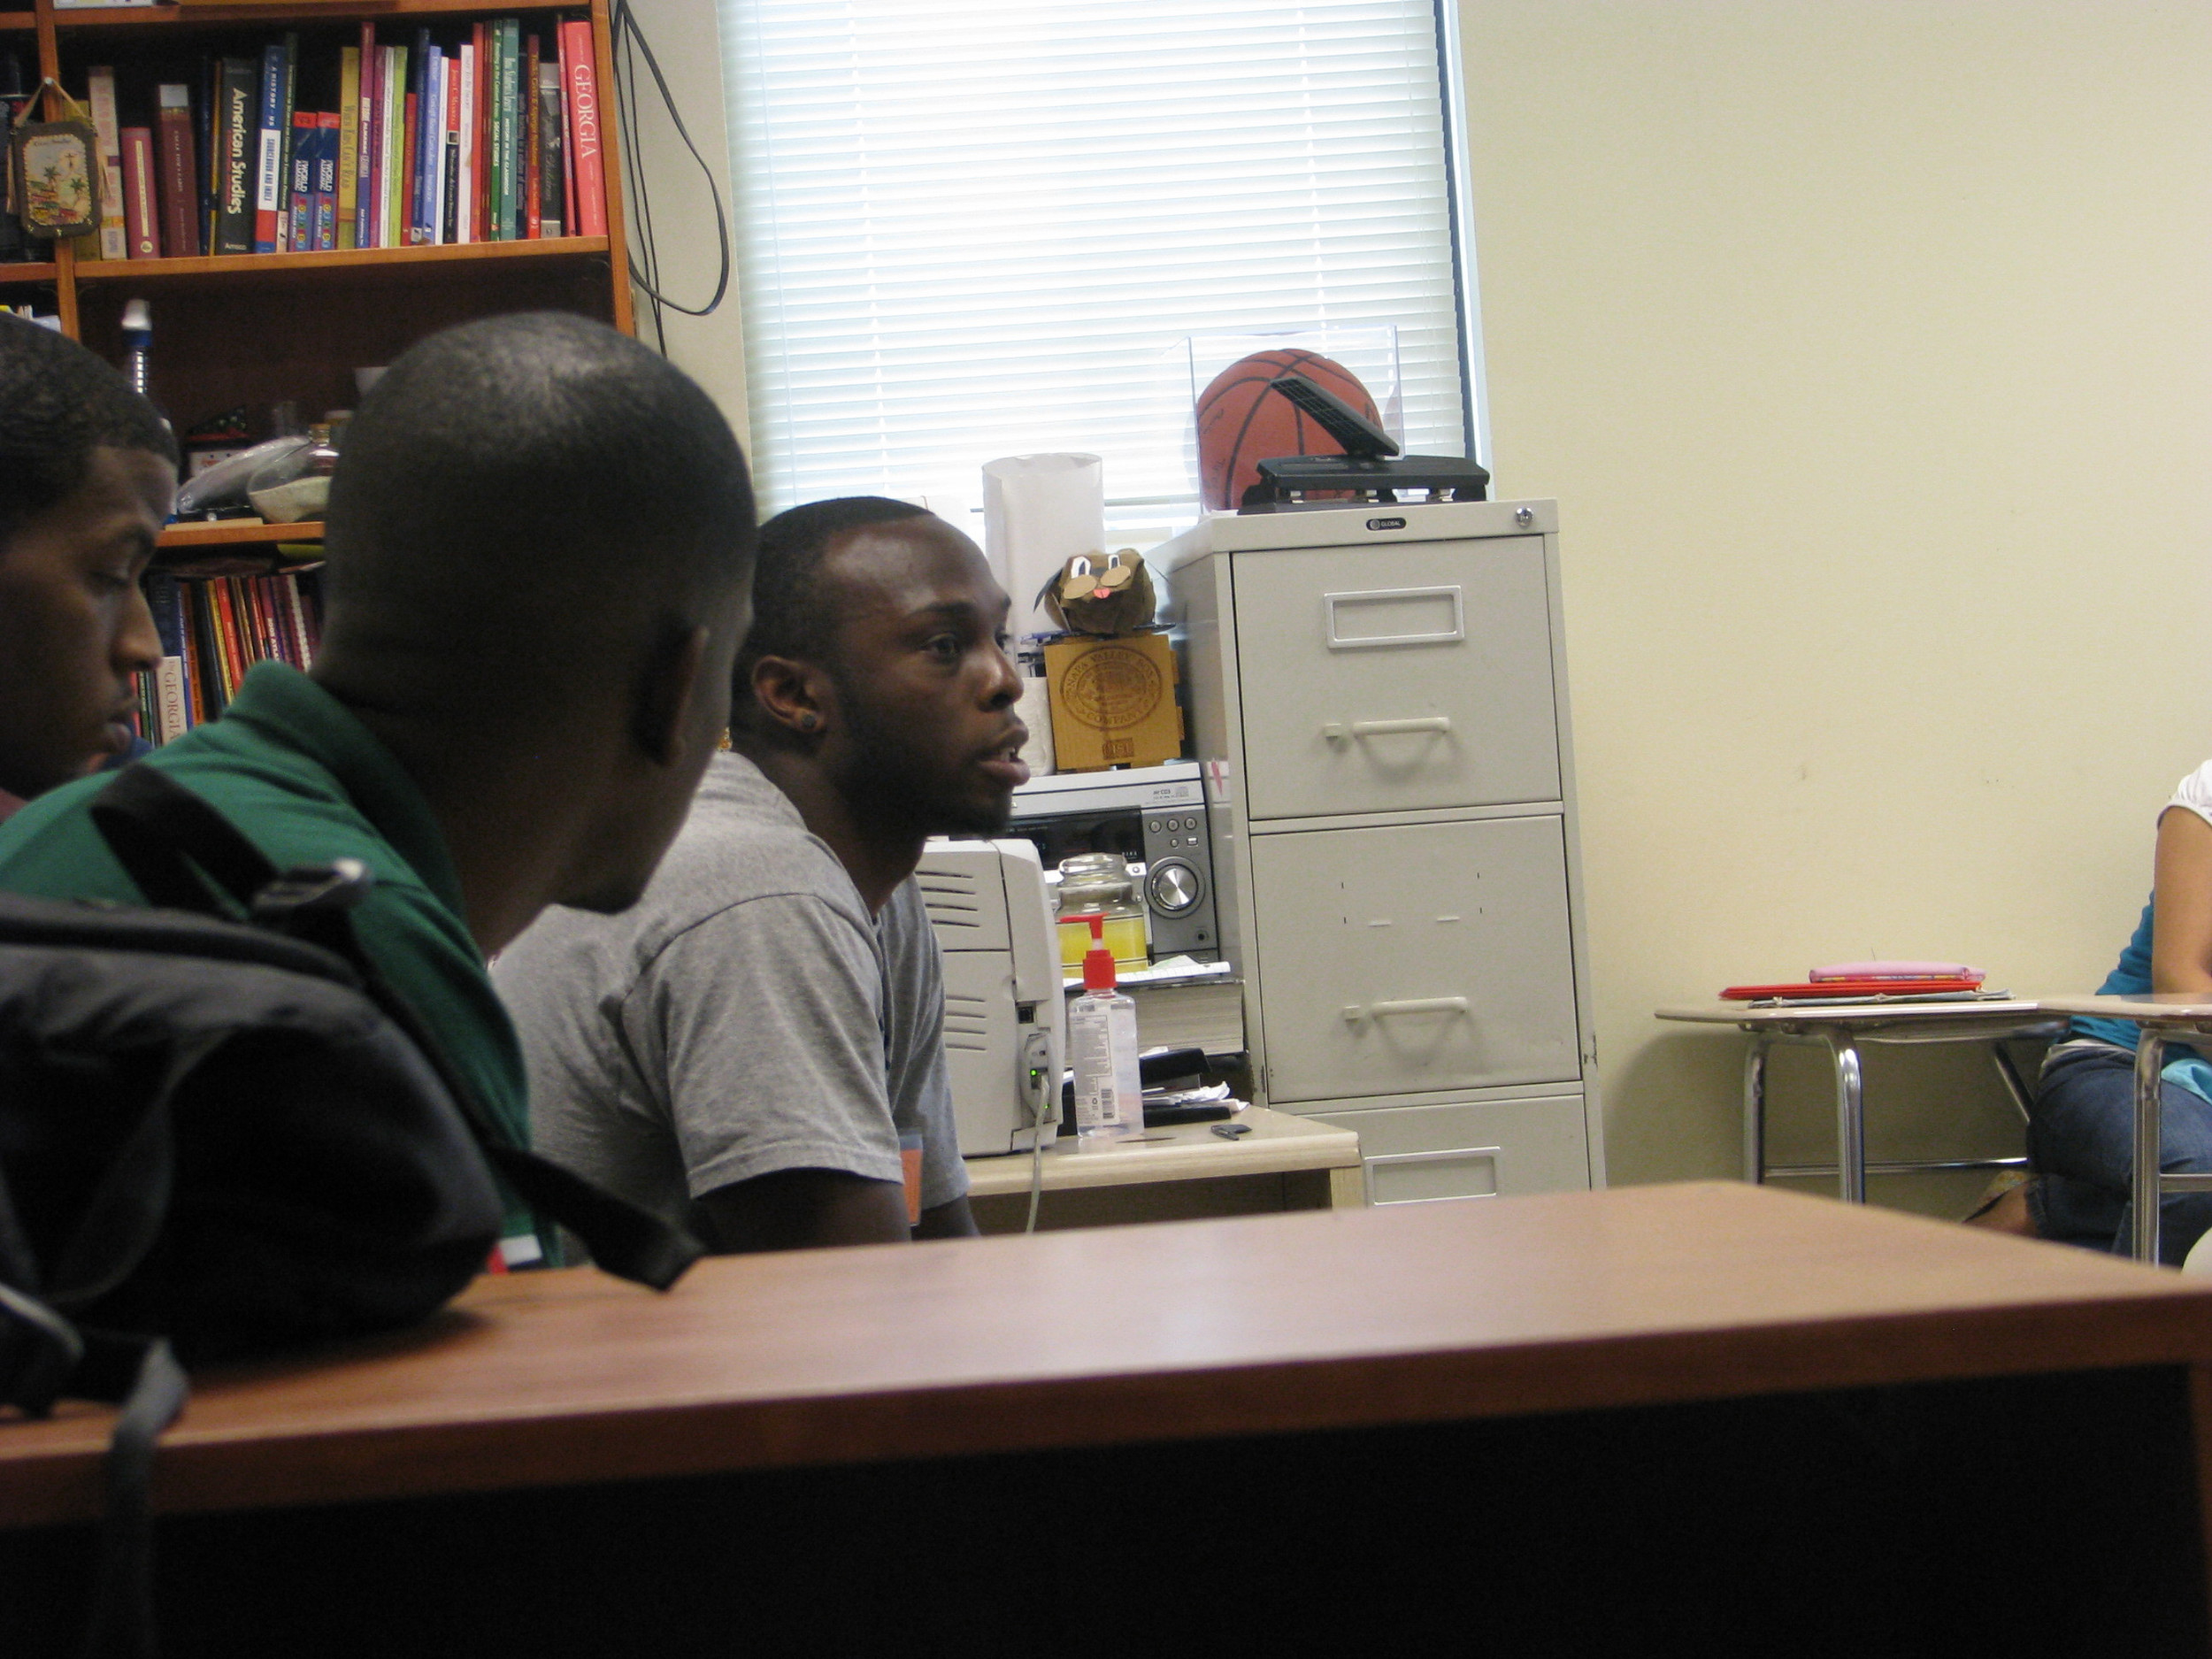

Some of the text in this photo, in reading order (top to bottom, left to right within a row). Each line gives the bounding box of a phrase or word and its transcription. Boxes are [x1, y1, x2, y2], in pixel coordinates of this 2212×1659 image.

[231, 88, 248, 157] American
[269, 115, 274, 126] US
[574, 65, 596, 158] GEORGIA
[227, 161, 246, 214] Studies
[1090, 649, 1132, 664] VALLEY
[165, 672, 180, 740] GEORGIA
